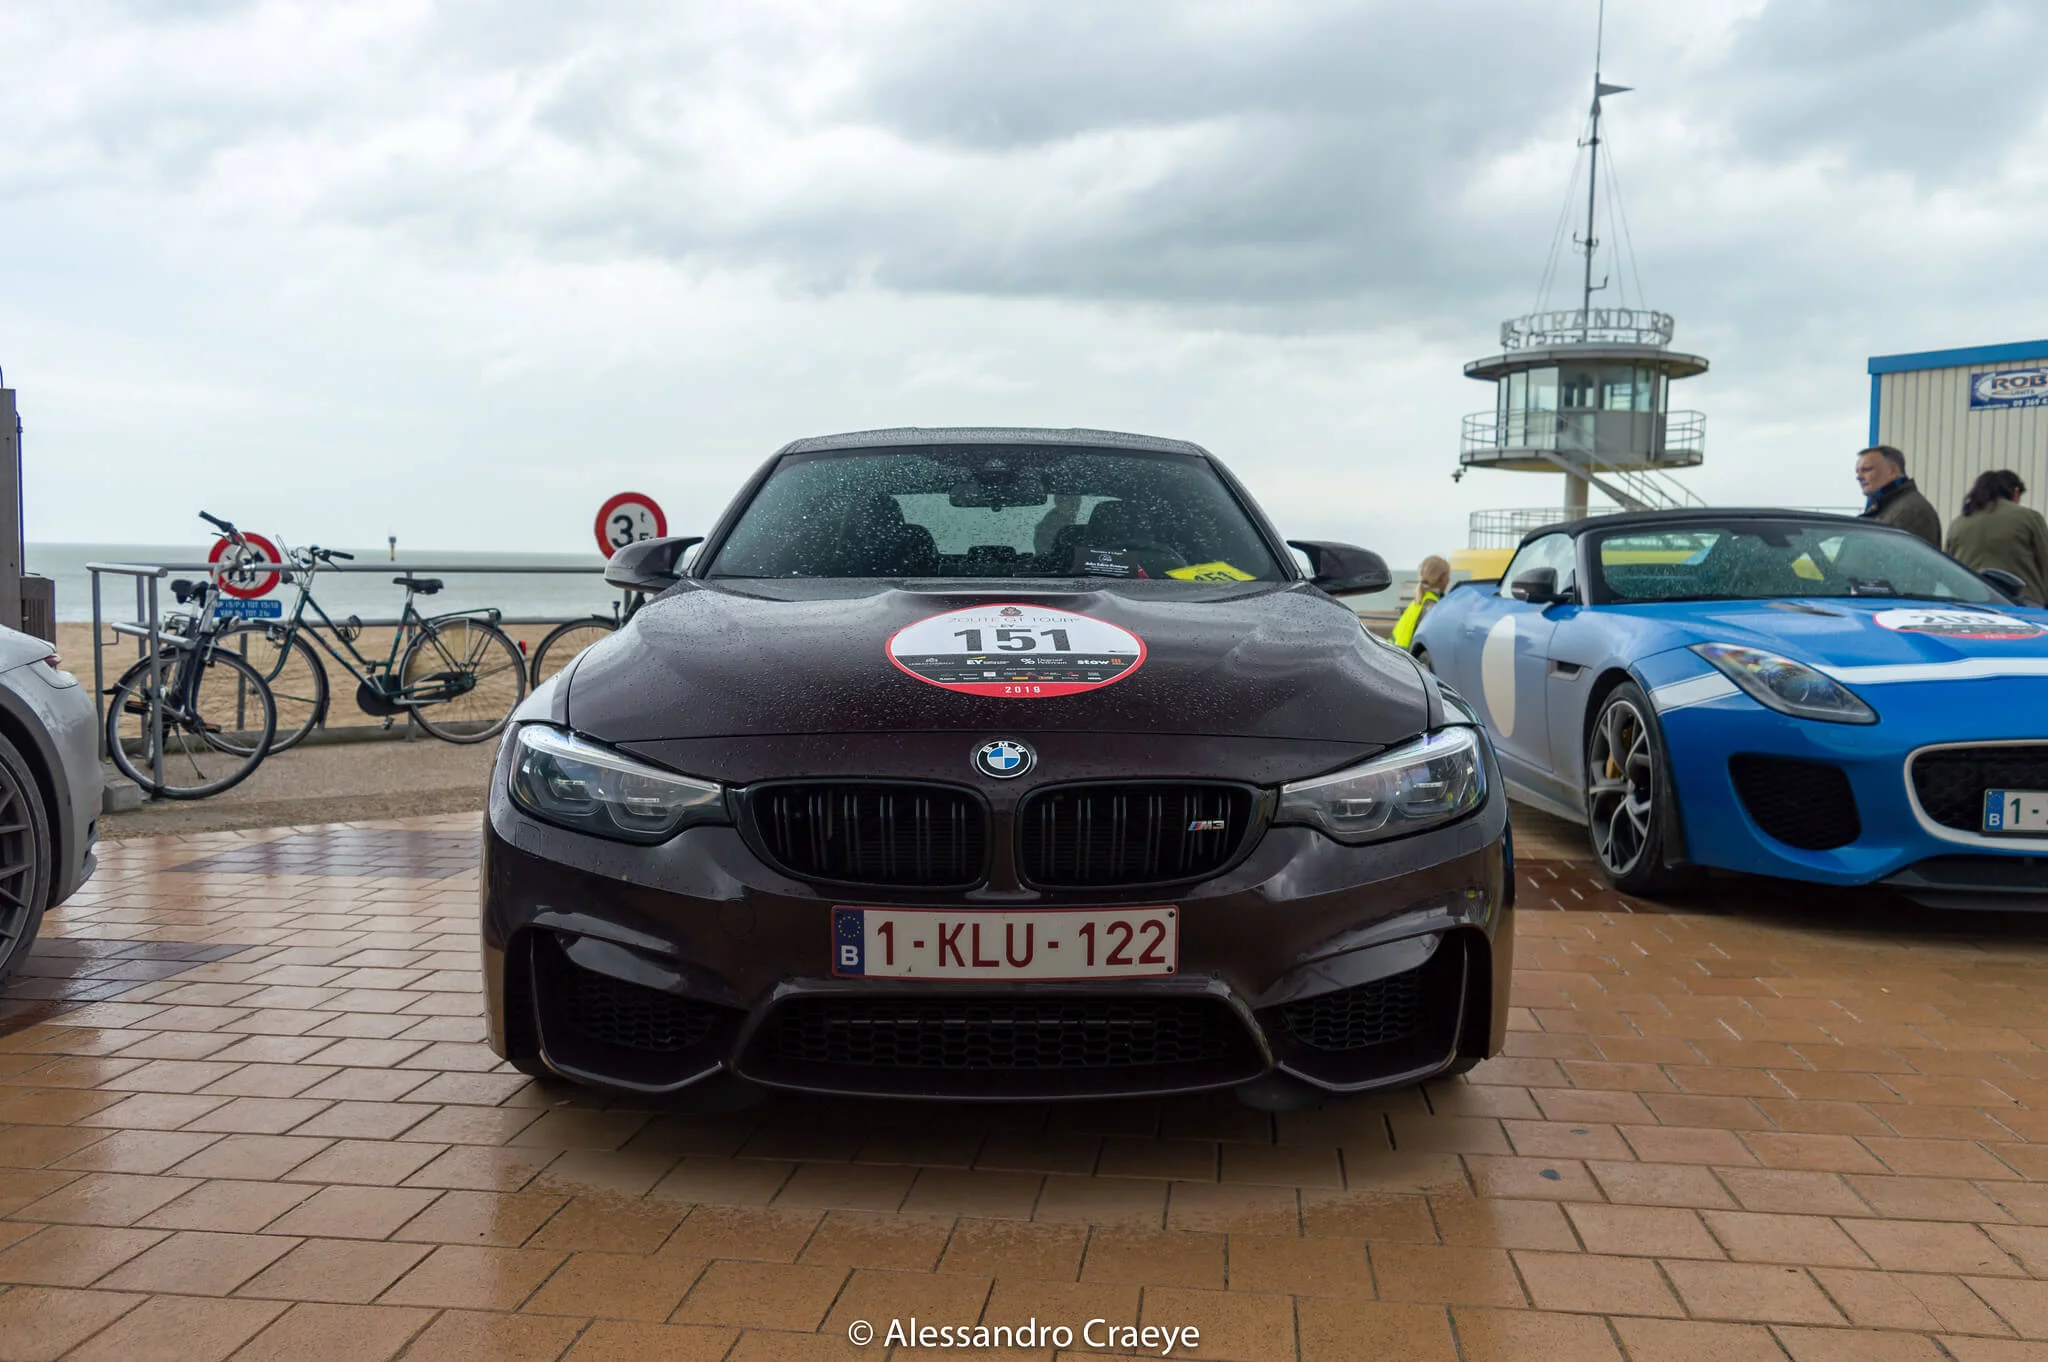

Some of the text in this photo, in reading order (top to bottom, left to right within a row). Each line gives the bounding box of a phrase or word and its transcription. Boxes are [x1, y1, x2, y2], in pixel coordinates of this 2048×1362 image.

[611, 514, 634, 548] 3
[954, 629, 1071, 651] 151
[982, 741, 1027, 753] BMW
[1988, 813, 2001, 826] B
[2010, 798, 2048, 825] 1-
[840, 945, 859, 966] B
